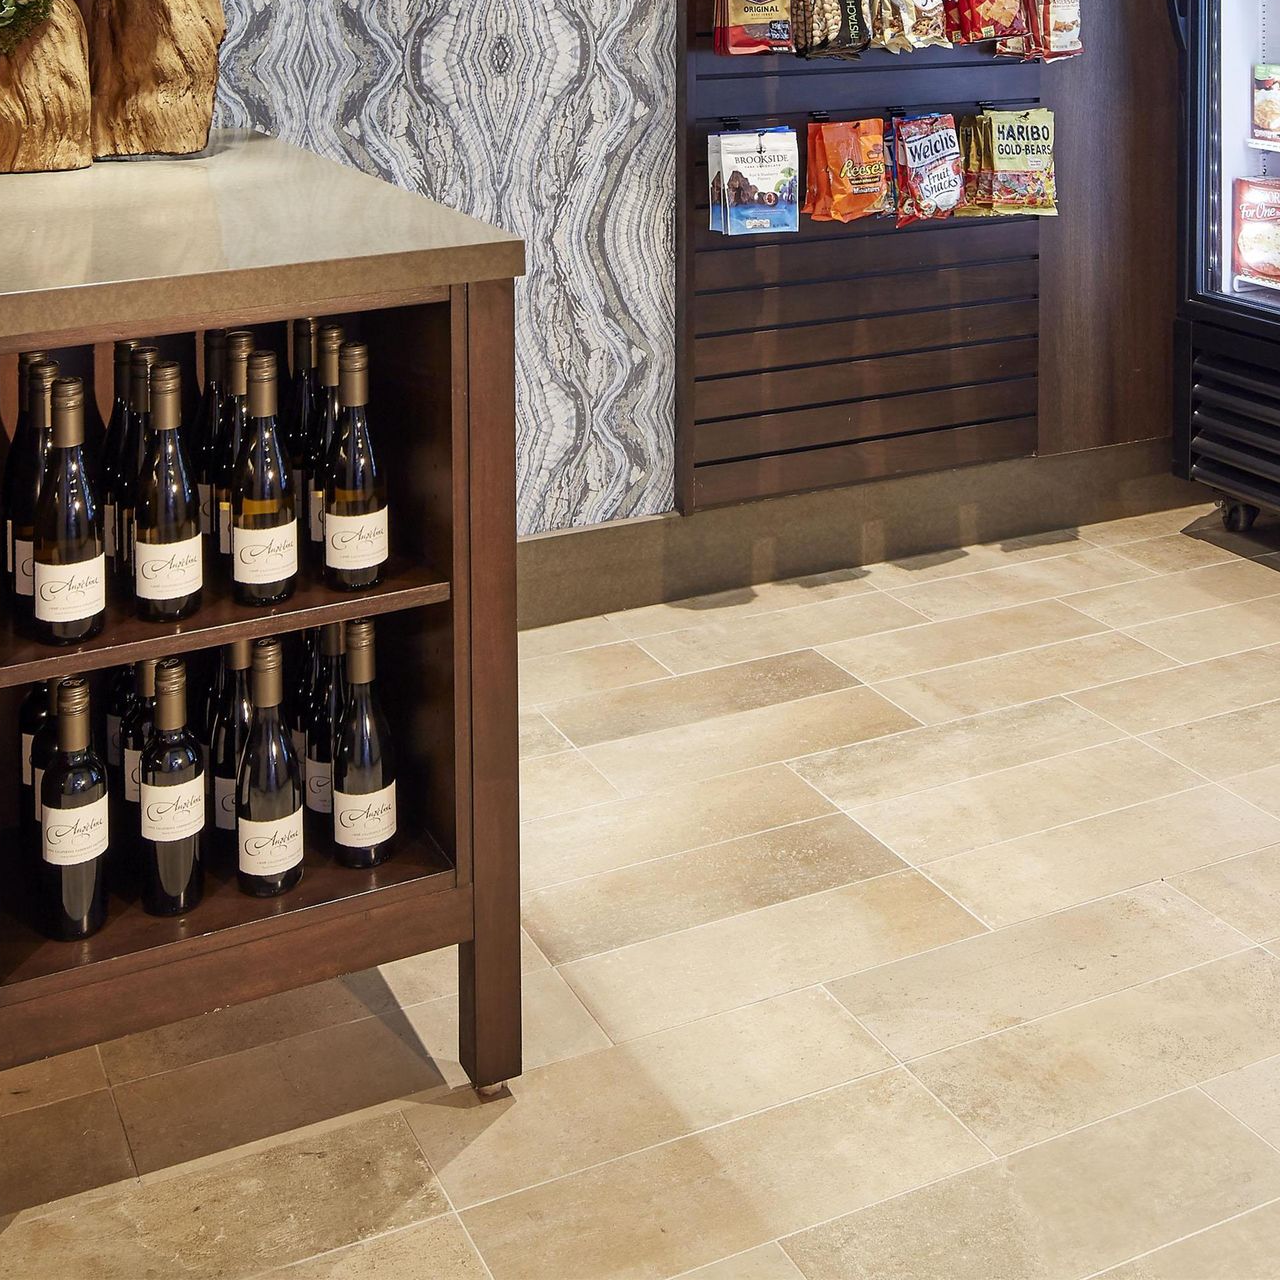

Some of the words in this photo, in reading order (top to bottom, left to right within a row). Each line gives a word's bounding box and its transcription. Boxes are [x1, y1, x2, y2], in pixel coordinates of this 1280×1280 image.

[997, 125, 1050, 141] HARIBO
[908, 132, 956, 163] Welch's
[998, 144, 1052, 155] GOLD-BEARS
[735, 154, 789, 164] BROOKSIDE
[841, 159, 885, 178] Reese's
[927, 167, 950, 184] Fruit
[924, 177, 958, 198] Snacks
[1240, 203, 1255, 219] For
[1257, 201, 1276, 218] One
